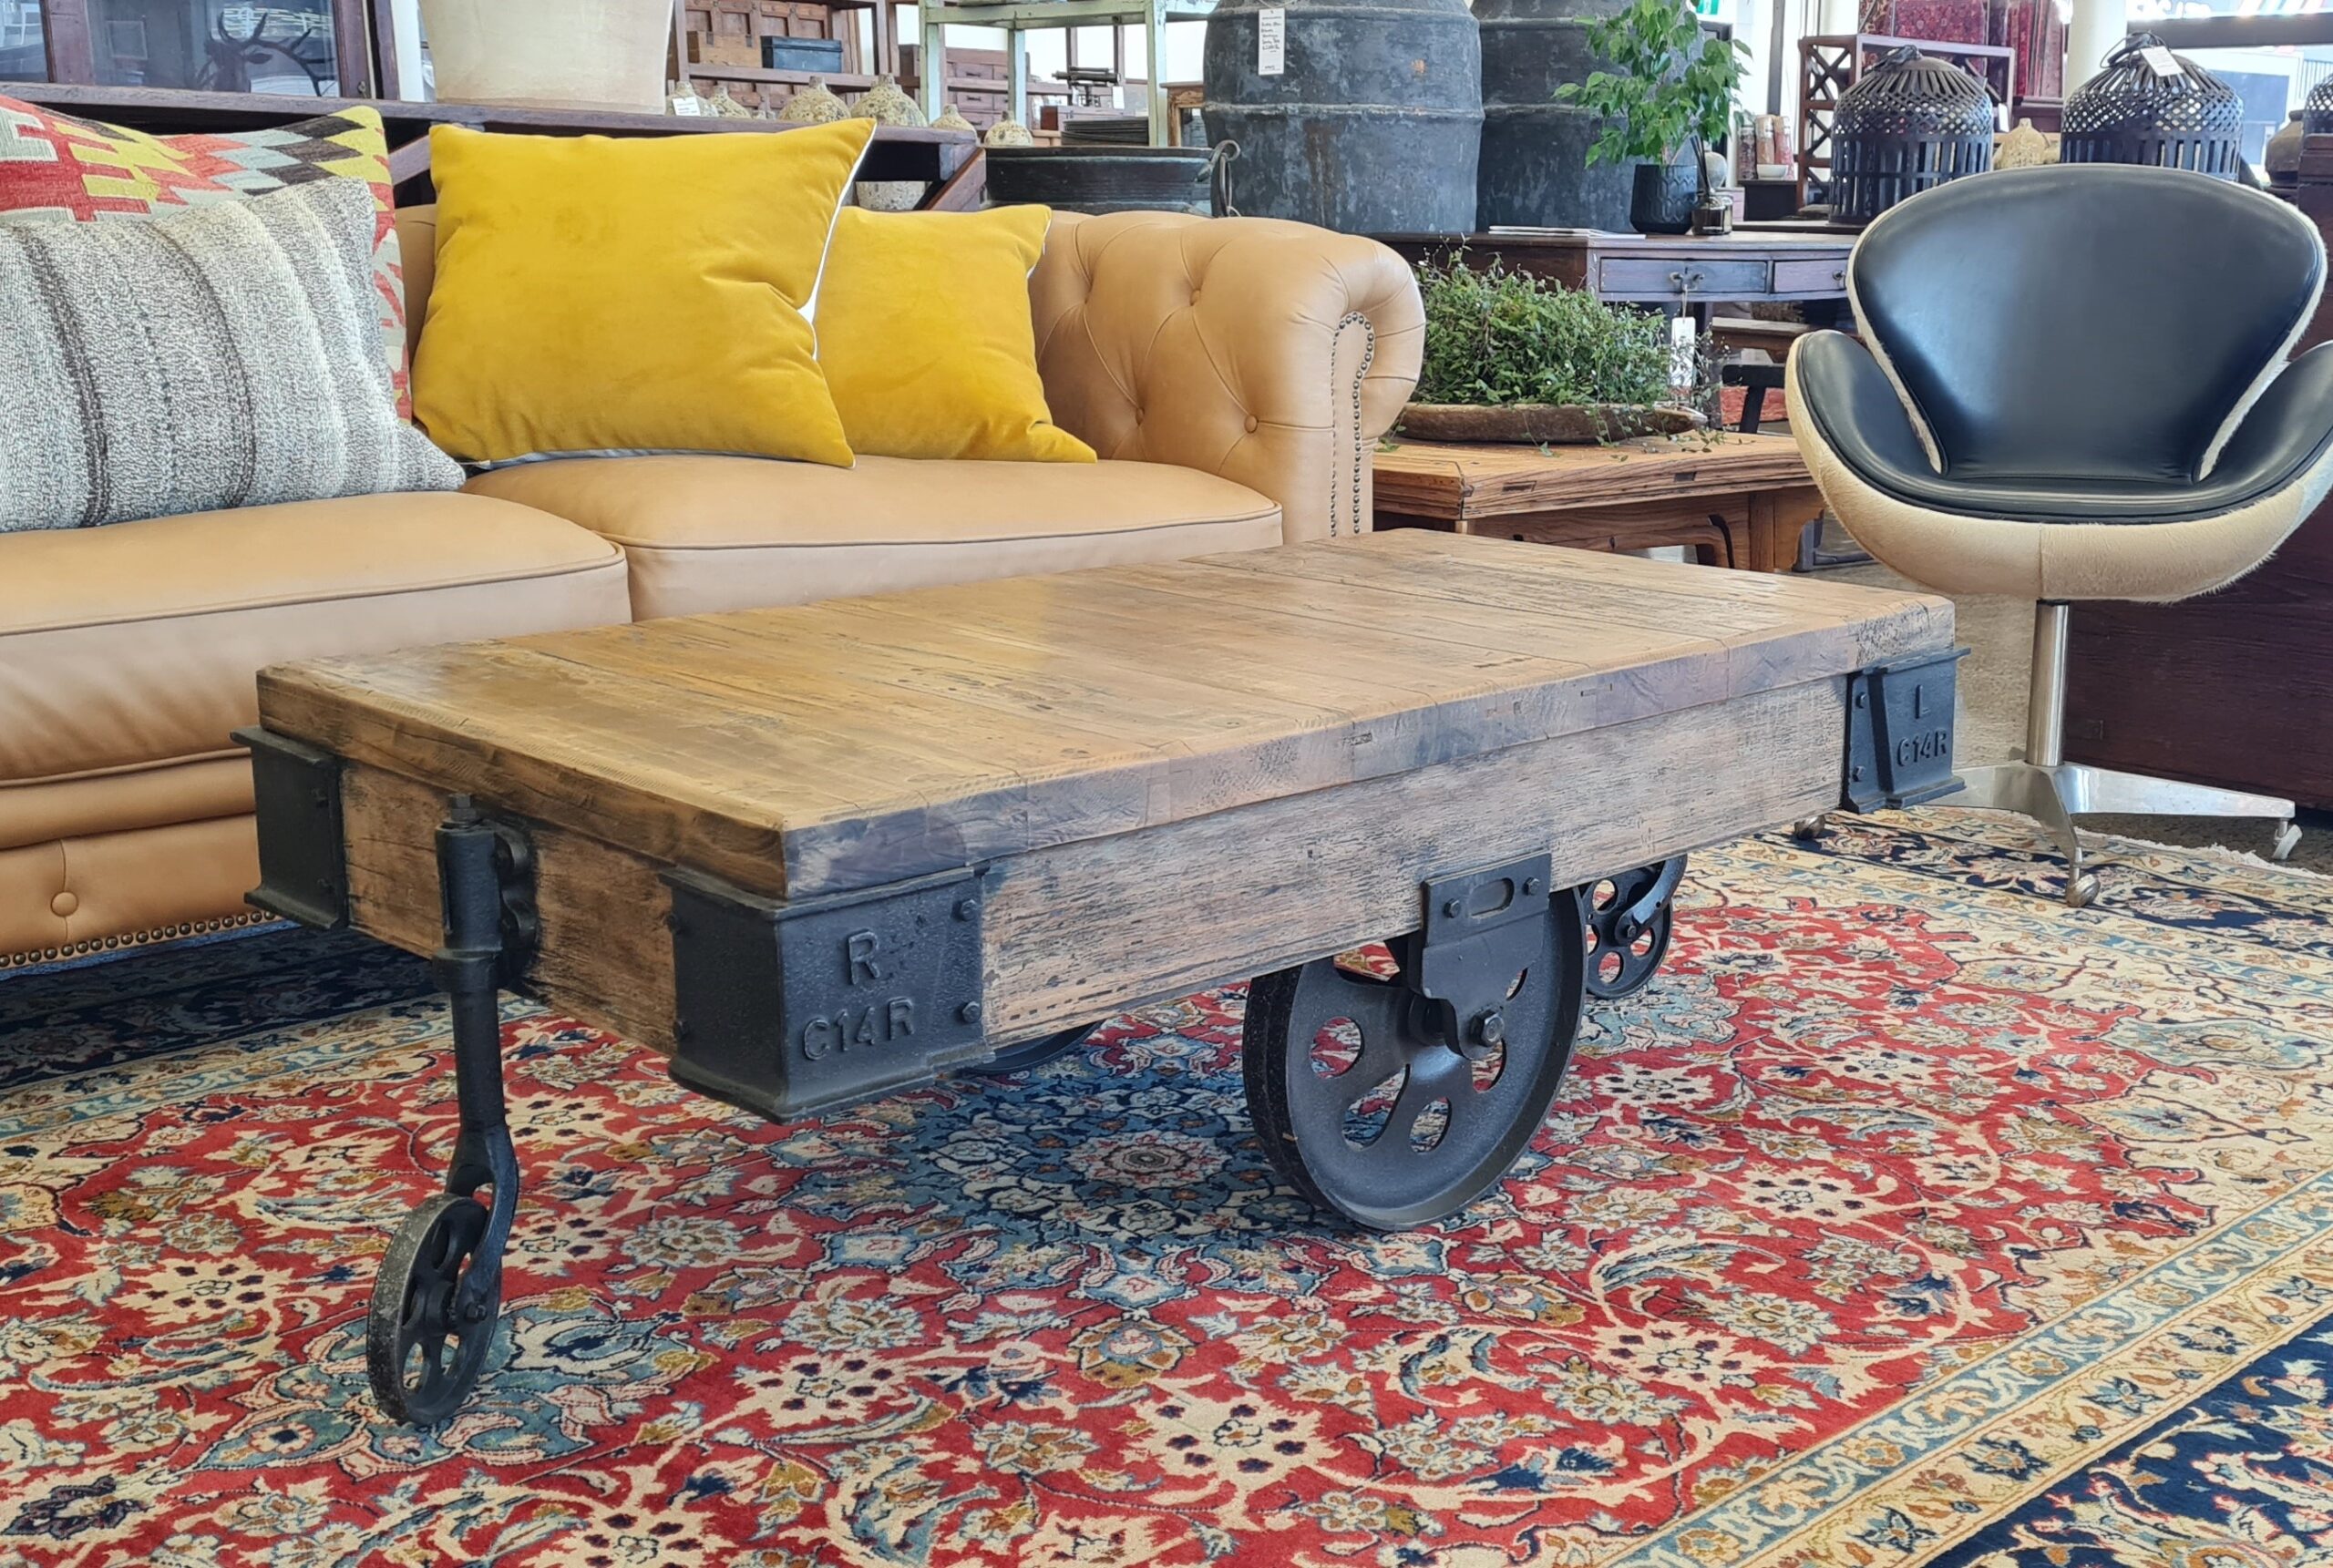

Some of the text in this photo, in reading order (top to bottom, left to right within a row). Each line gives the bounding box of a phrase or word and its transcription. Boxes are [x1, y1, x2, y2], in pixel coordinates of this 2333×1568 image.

[1896, 728, 1948, 767] C14R
[847, 927, 880, 986] R
[803, 996, 914, 1061] C14R
